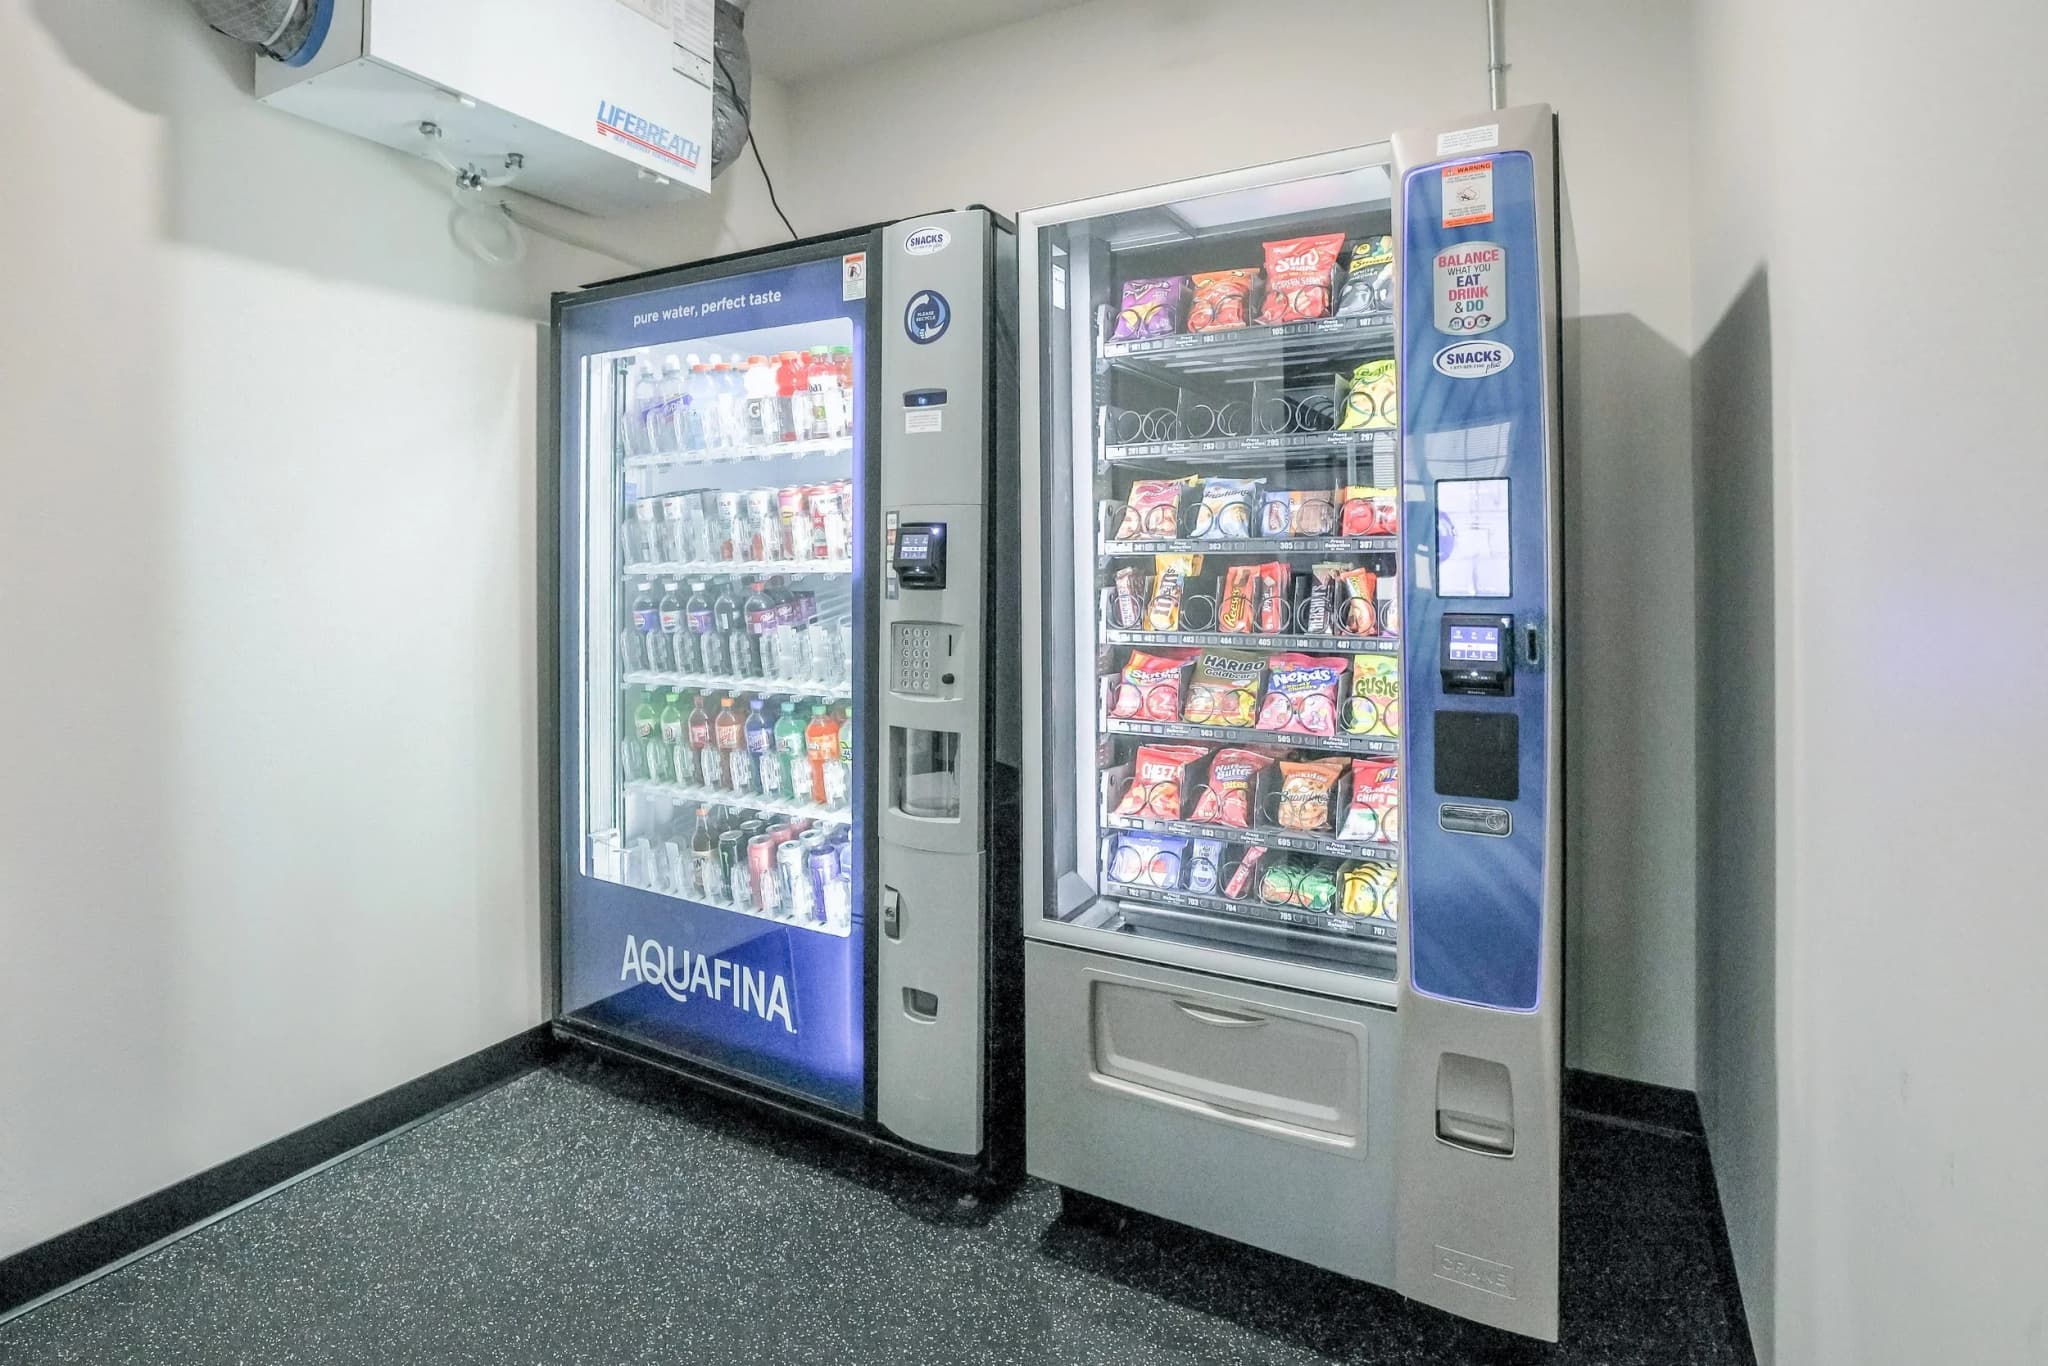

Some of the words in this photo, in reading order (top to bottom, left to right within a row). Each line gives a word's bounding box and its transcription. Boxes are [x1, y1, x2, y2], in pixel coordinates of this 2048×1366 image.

[597, 100, 700, 163] LIFEBREATH
[1457, 163, 1491, 173] WARNING
[910, 233, 943, 247] SNACKS
[1438, 249, 1499, 268] BALANCE
[1447, 265, 1471, 276] WHAT
[1474, 263, 1491, 273] YOU
[1456, 274, 1480, 288] EAT
[1448, 286, 1489, 301] DRINK
[633, 312, 659, 328] pure
[662, 305, 698, 319] water,
[701, 294, 746, 317] perfect
[749, 289, 782, 306] taste
[1454, 301, 1464, 313] &
[1466, 299, 1484, 312] DO
[1446, 350, 1502, 365] SNACKS
[1204, 654, 1265, 670] HARIBO
[621, 934, 793, 1033] AQUAFINA
